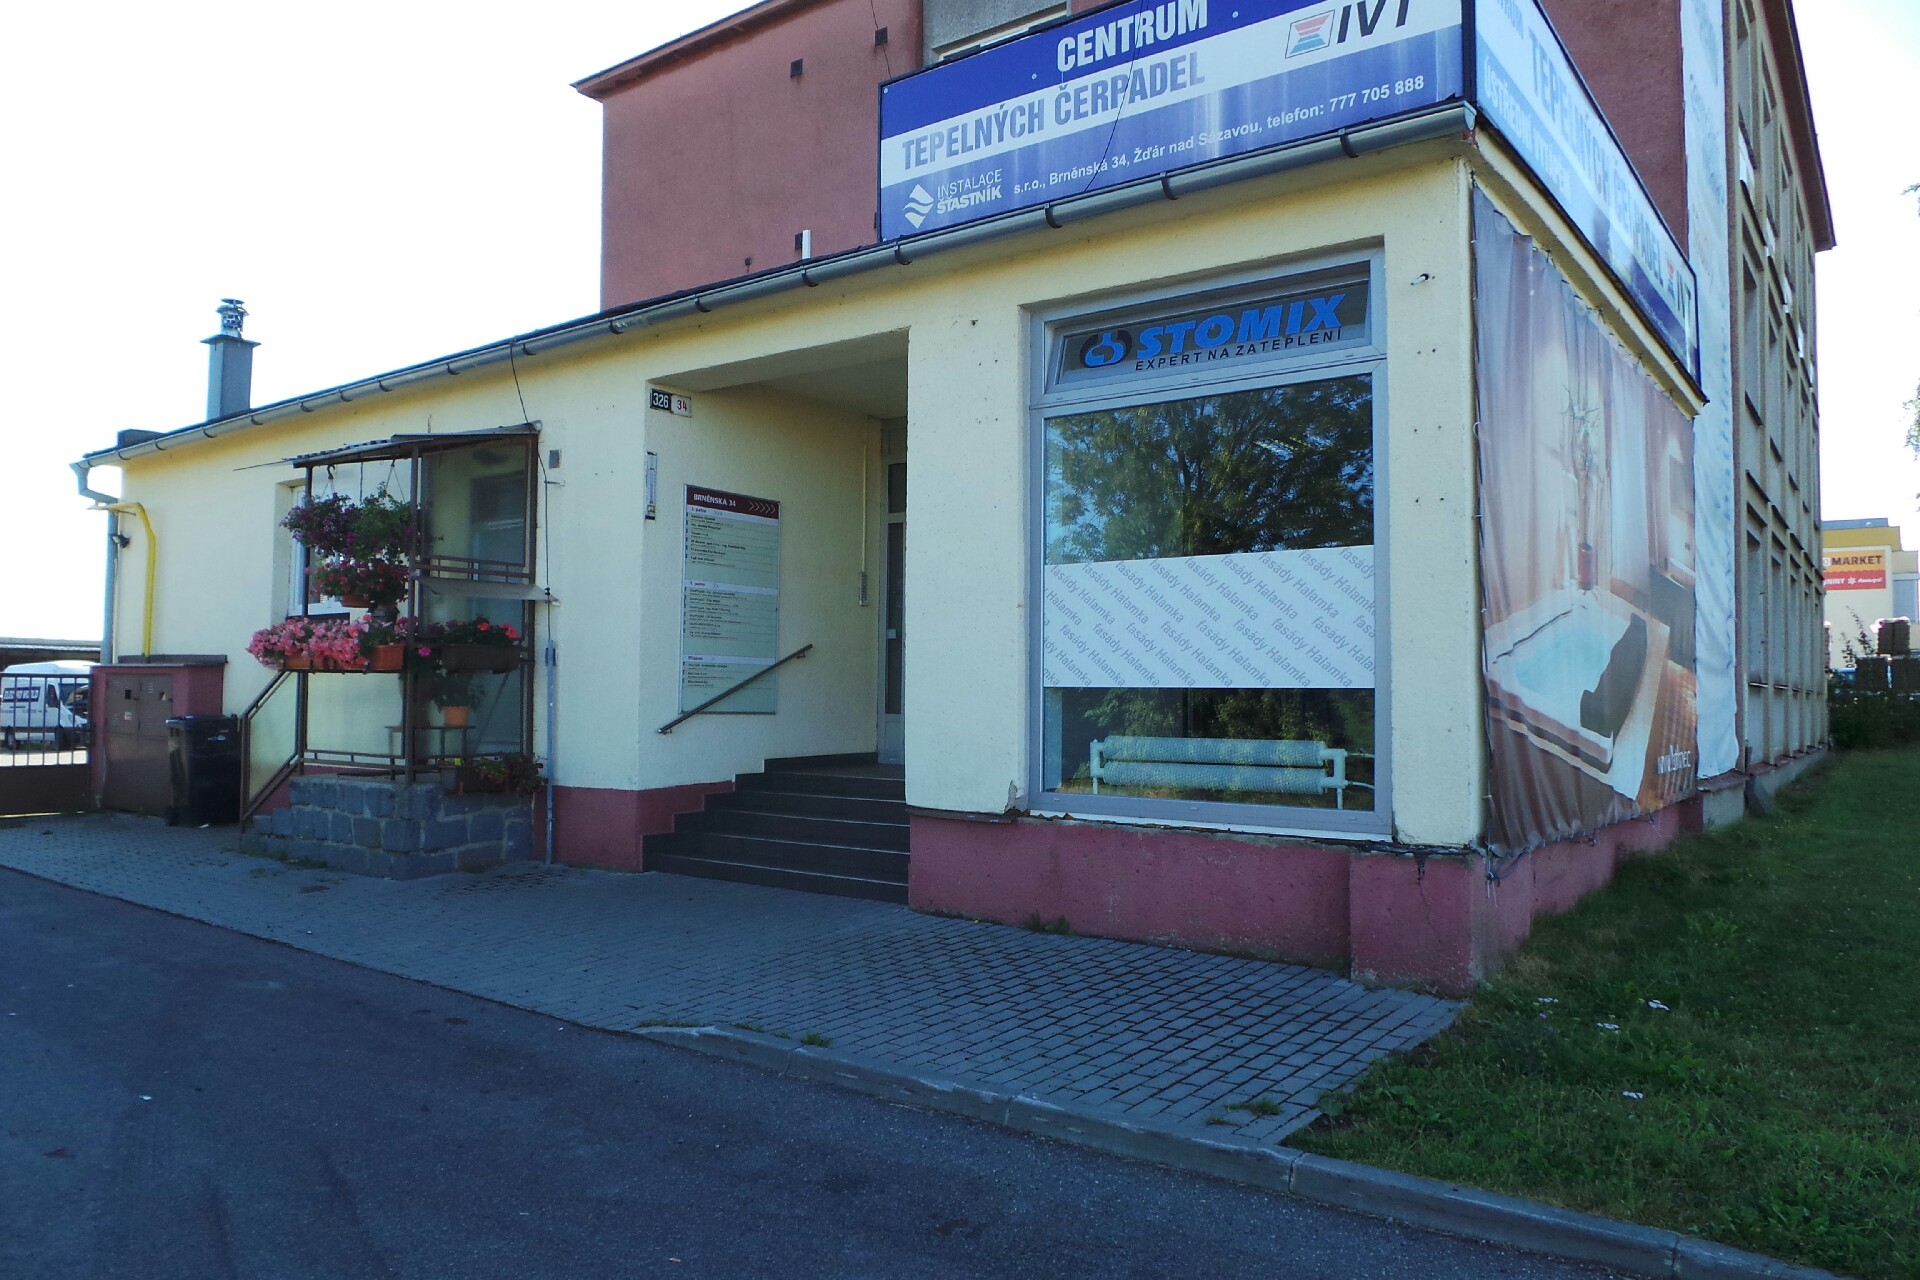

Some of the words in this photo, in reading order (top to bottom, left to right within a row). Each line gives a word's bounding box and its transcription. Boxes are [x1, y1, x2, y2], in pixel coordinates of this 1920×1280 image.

[1057, 0, 1208, 72] CENTRUM
[902, 98, 1045, 171] TEPELNÝCH
[1055, 51, 1206, 126] ČERPADEL
[1049, 158, 1108, 185] Brněnská
[1111, 152, 1131, 171] 34,
[1133, 141, 1165, 163] Žďár
[1169, 136, 1195, 154] nad
[1198, 122, 1263, 147] Sázavou,
[1267, 104, 1325, 130] telefon:
[1329, 92, 1358, 112] 777
[1360, 83, 1390, 104] 705
[1394, 74, 1425, 95] 888
[937, 168, 1002, 199] INSTALACE
[1135, 352, 1203, 371] EXPERT
[1207, 348, 1230, 361] NA
[1237, 326, 1342, 356] ZATEPLENÍ
[1136, 294, 1346, 360] STOMIX
[653, 393, 669, 408] 326
[676, 400, 688, 411] 34
[693, 493, 728, 507] BRNĚNSKÁ
[1050, 564, 1080, 593] fasády
[1077, 589, 1115, 625] Halamka
[1082, 562, 1113, 591] fasády
[1110, 588, 1149, 624] Halamka
[1115, 560, 1147, 590] fasády
[1144, 586, 1184, 623] Halamka
[1150, 558, 1181, 589] fasády
[1180, 584, 1222, 622] Halamka
[1184, 556, 1218, 587] fasády
[1216, 582, 1259, 621] Halamka
[1221, 554, 1255, 585] fasády
[1254, 580, 1298, 620] Halamka
[1258, 552, 1295, 583] fasády
[1292, 579, 1339, 618] Halamka
[1298, 550, 1335, 581] fasády
[1046, 590, 1082, 626] Halamka
[1311, 617, 1350, 649] fasády
[1055, 650, 1092, 686] Halamka
[1061, 624, 1090, 654] fasády
[1088, 650, 1126, 686] Halamka
[1093, 623, 1123, 653] fasády
[1121, 649, 1160, 687] Halamka
[1126, 622, 1157, 652] fasády
[1155, 649, 1196, 687] Halamka
[1160, 621, 1193, 652] fasády
[1191, 648, 1233, 687] Halamka
[1195, 620, 1231, 651] fasády
[1228, 648, 1271, 687] Halamka
[1233, 619, 1268, 651] fasády
[1266, 647, 1311, 687] Halamka
[1271, 618, 1309, 650] fasády
[1305, 646, 1352, 687] Halamka
